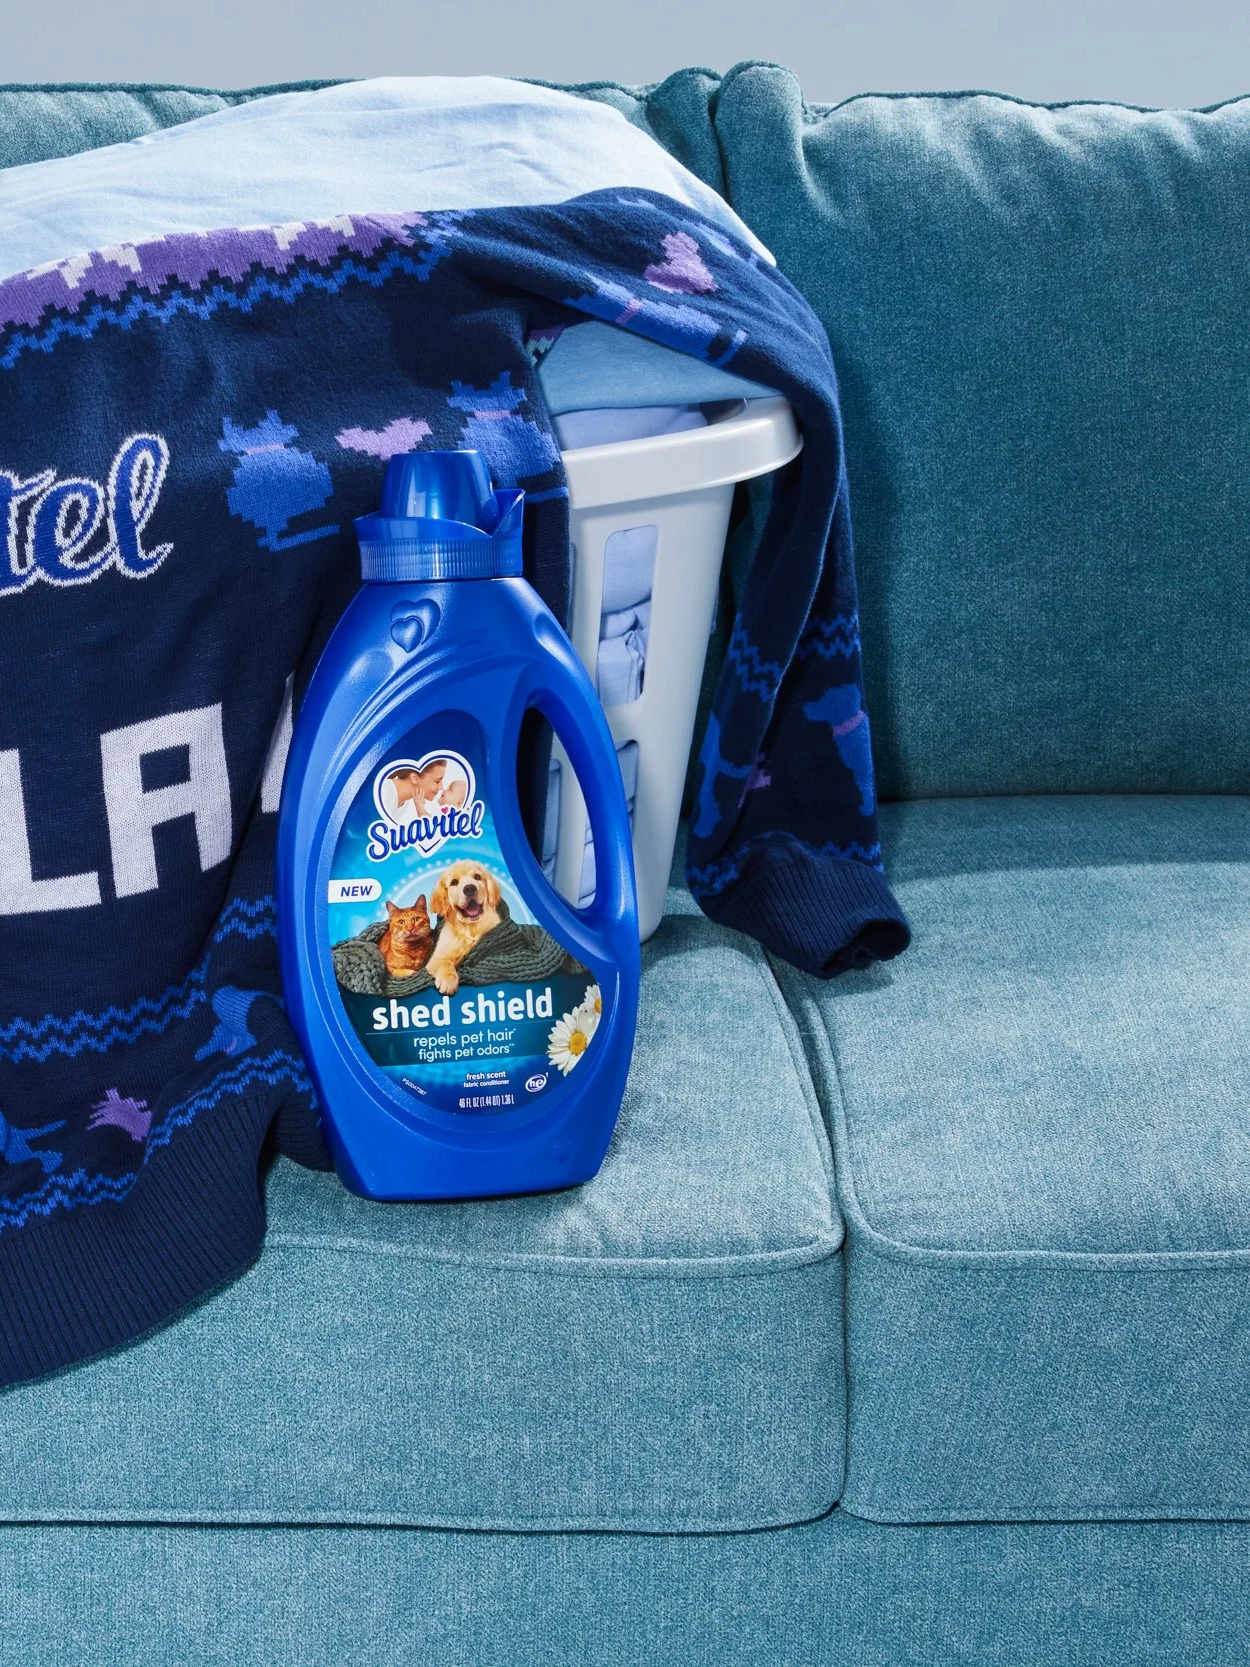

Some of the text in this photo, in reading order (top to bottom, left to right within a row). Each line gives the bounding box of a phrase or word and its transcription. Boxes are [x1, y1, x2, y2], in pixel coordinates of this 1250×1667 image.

[368, 802, 483, 861] Suavitel
[340, 885, 373, 897] NEW
[372, 987, 553, 1030] shed shield
[413, 1032, 457, 1049] repels
[461, 1031, 484, 1047] pet
[418, 1048, 452, 1062] fights
[455, 1046, 474, 1060] pet
[466, 1071, 506, 1080] fresh scent
[480, 1079, 510, 1087] conditioner
[459, 1097, 466, 1109] 46
